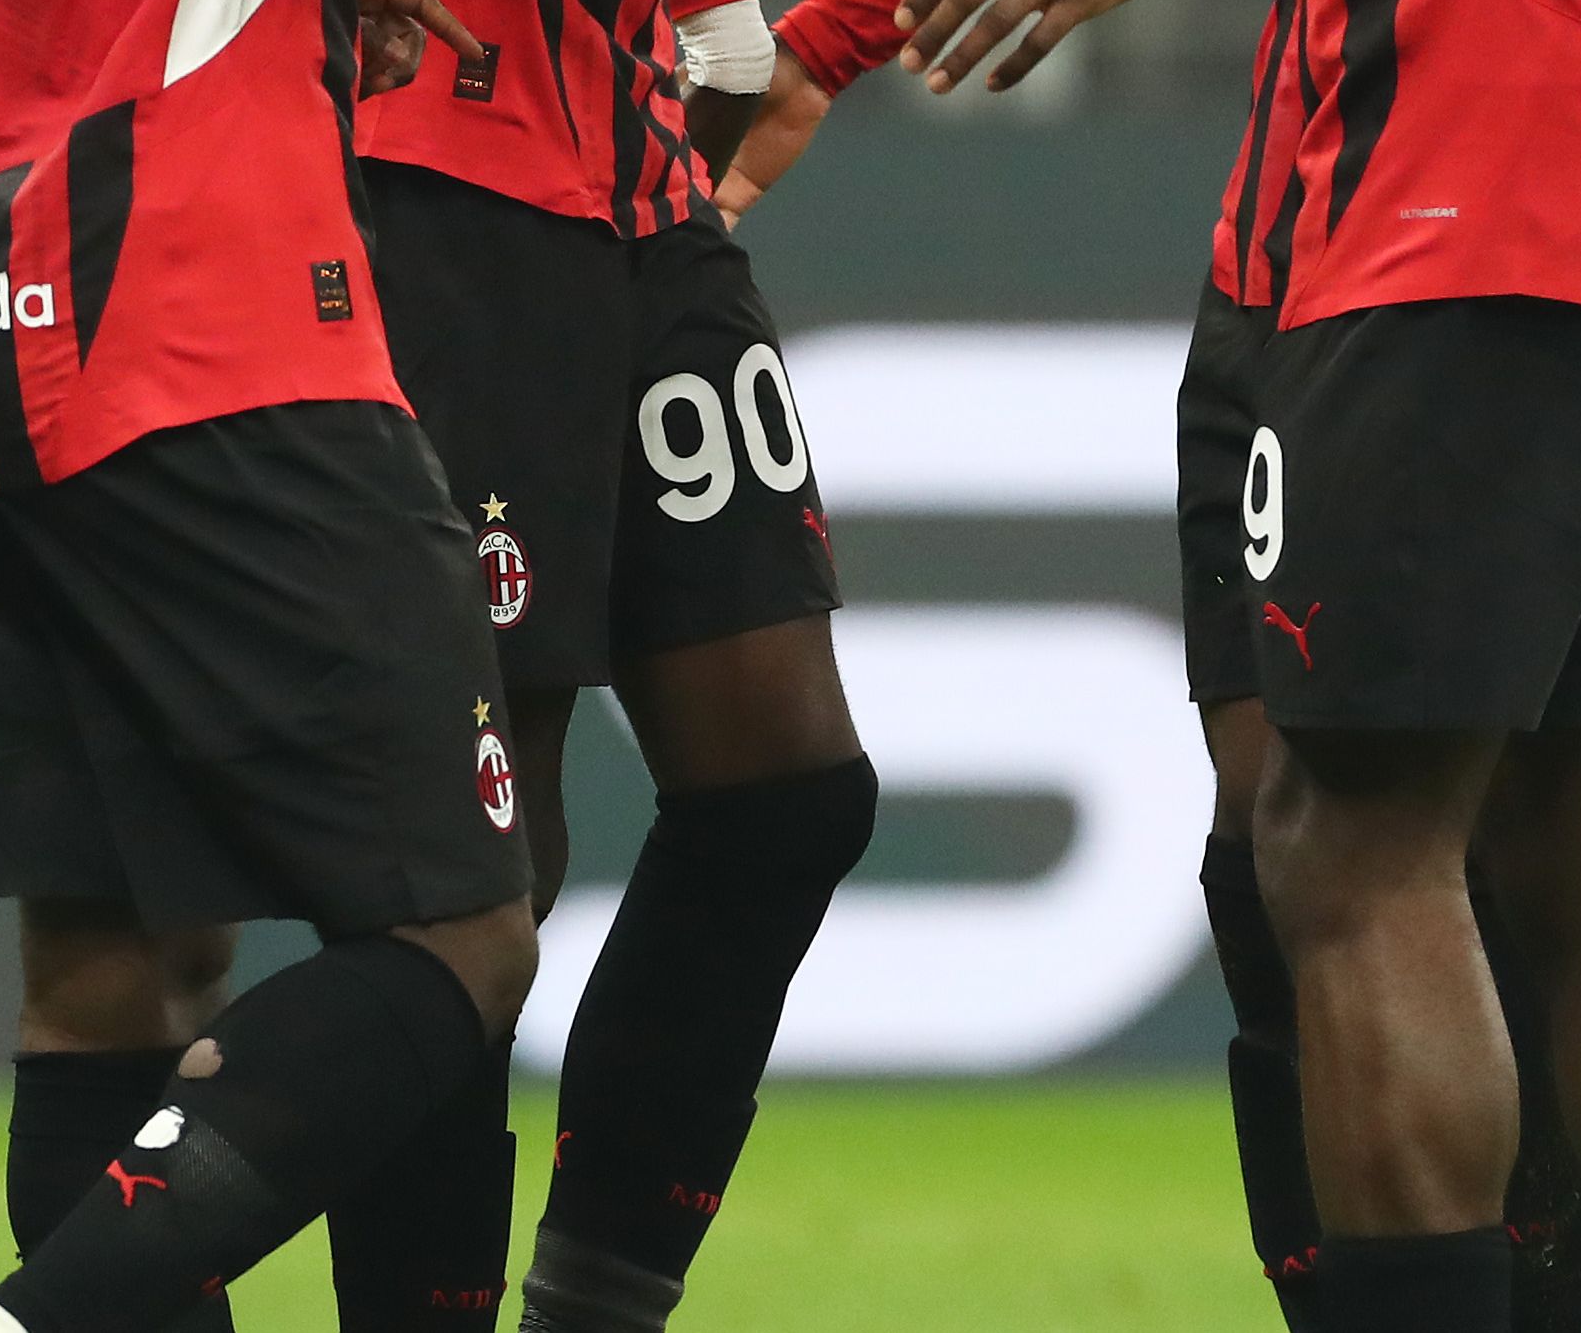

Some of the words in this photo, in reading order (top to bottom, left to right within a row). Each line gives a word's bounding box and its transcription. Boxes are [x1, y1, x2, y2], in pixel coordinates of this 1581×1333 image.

[638, 342, 809, 524] 90
[481, 534, 516, 554] ACM
[490, 606, 517, 618] 899
